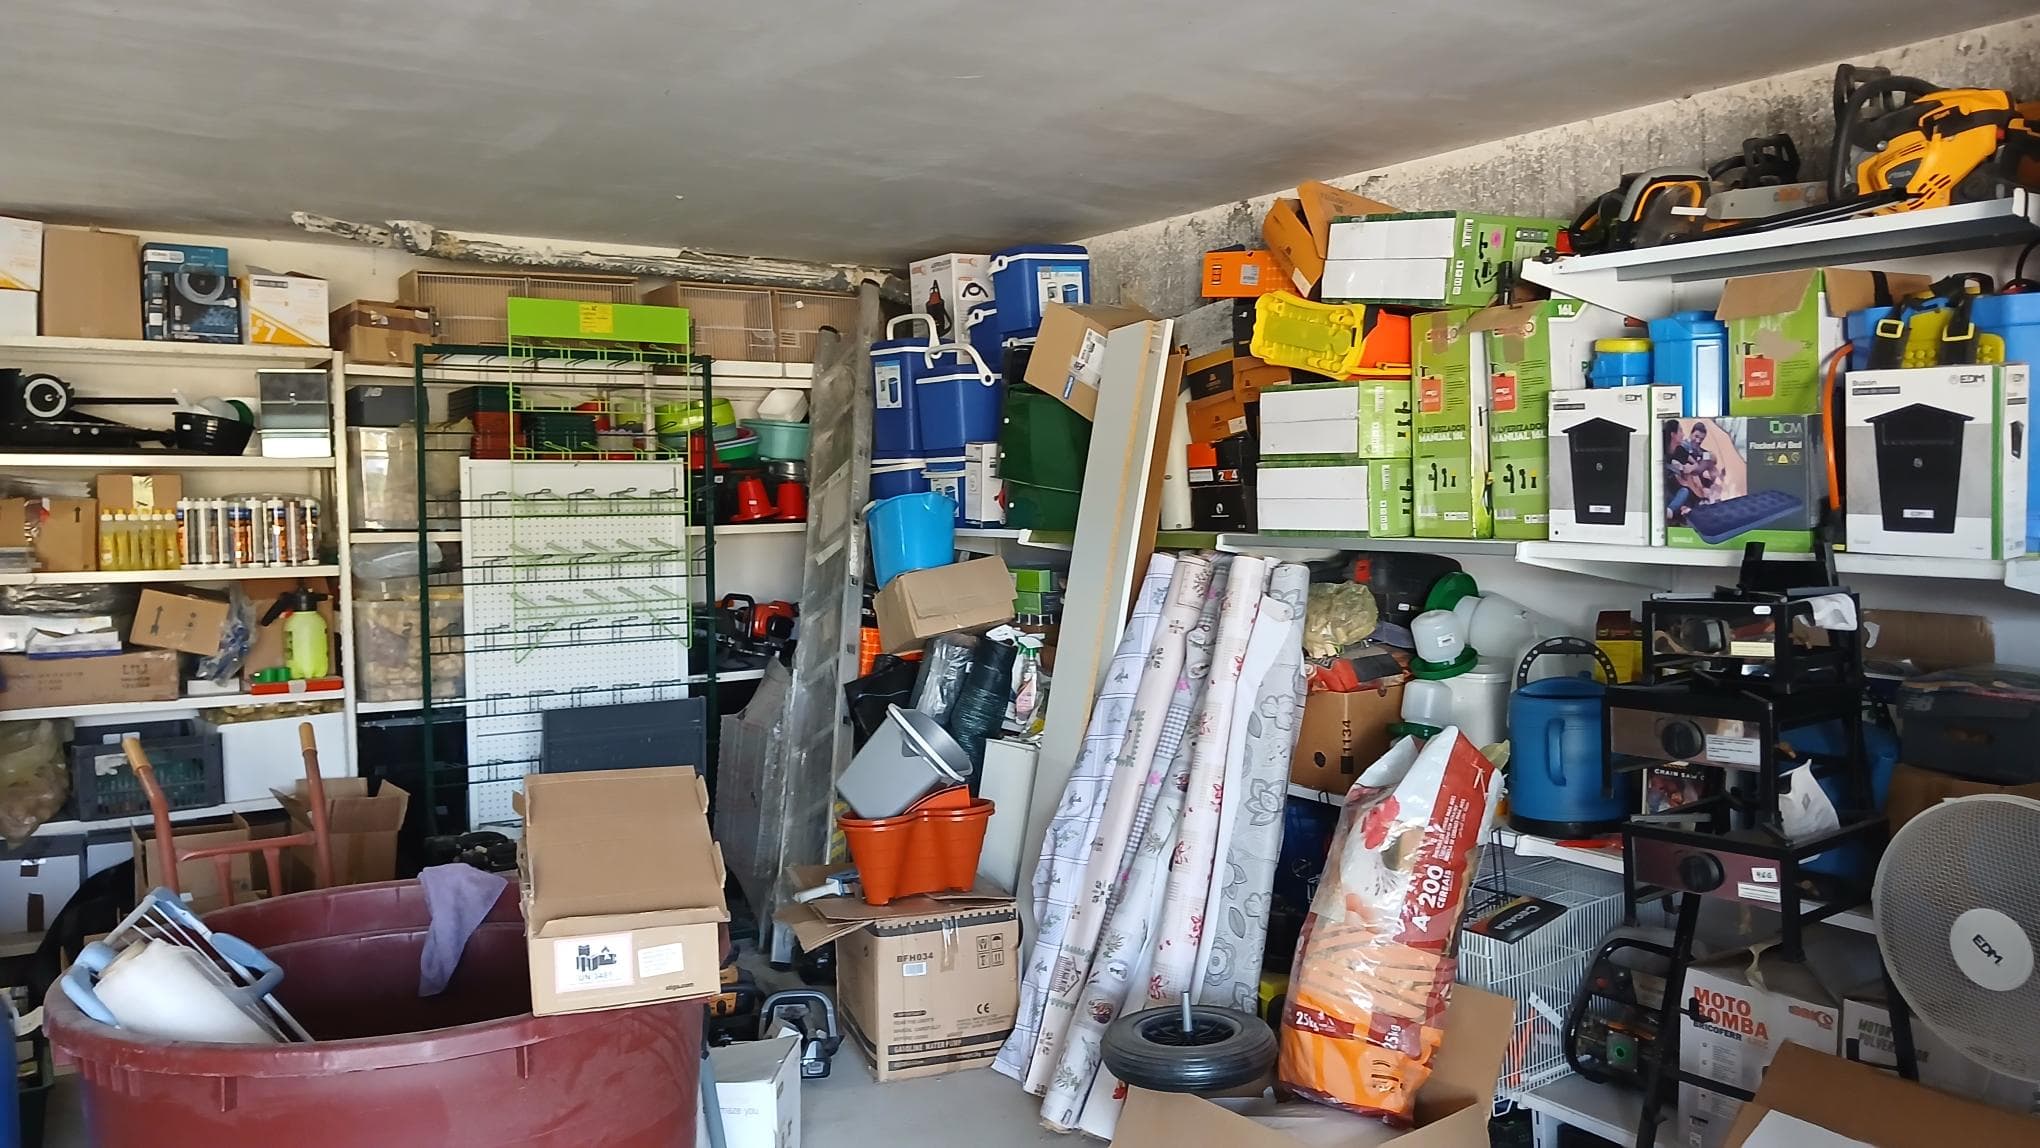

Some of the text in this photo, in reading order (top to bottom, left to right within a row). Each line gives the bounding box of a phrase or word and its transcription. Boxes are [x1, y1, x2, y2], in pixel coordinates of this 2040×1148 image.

[1557, 304, 1576, 316] 16L
[1960, 375, 1985, 384] EDM
[1342, 719, 1352, 755] 1134
[1654, 768, 1679, 777] CHAIN
[1417, 865, 1444, 909] 200
[896, 952, 934, 963] BFH034
[1972, 934, 2004, 965] EDM
[1693, 986, 1752, 1017] MOTO
[1295, 1010, 1320, 1033] 25kg
[1697, 1003, 1769, 1040] BOMBA
